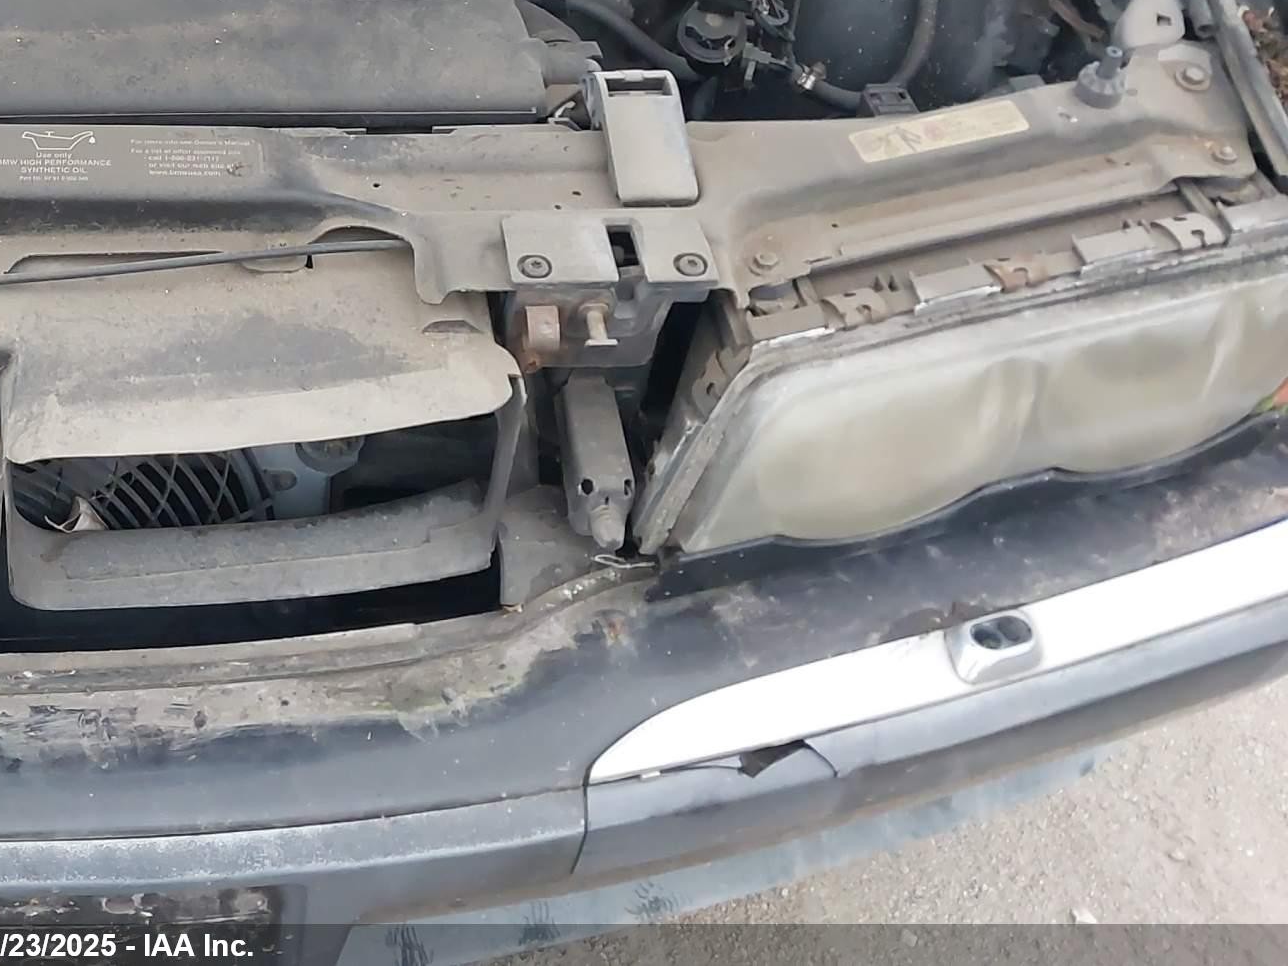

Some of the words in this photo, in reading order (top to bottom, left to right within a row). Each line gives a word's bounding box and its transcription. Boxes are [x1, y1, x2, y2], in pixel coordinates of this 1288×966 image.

[54, 152, 72, 160] only
[21, 166, 70, 174] SYNTHETIC
[72, 166, 88, 174] OIL
